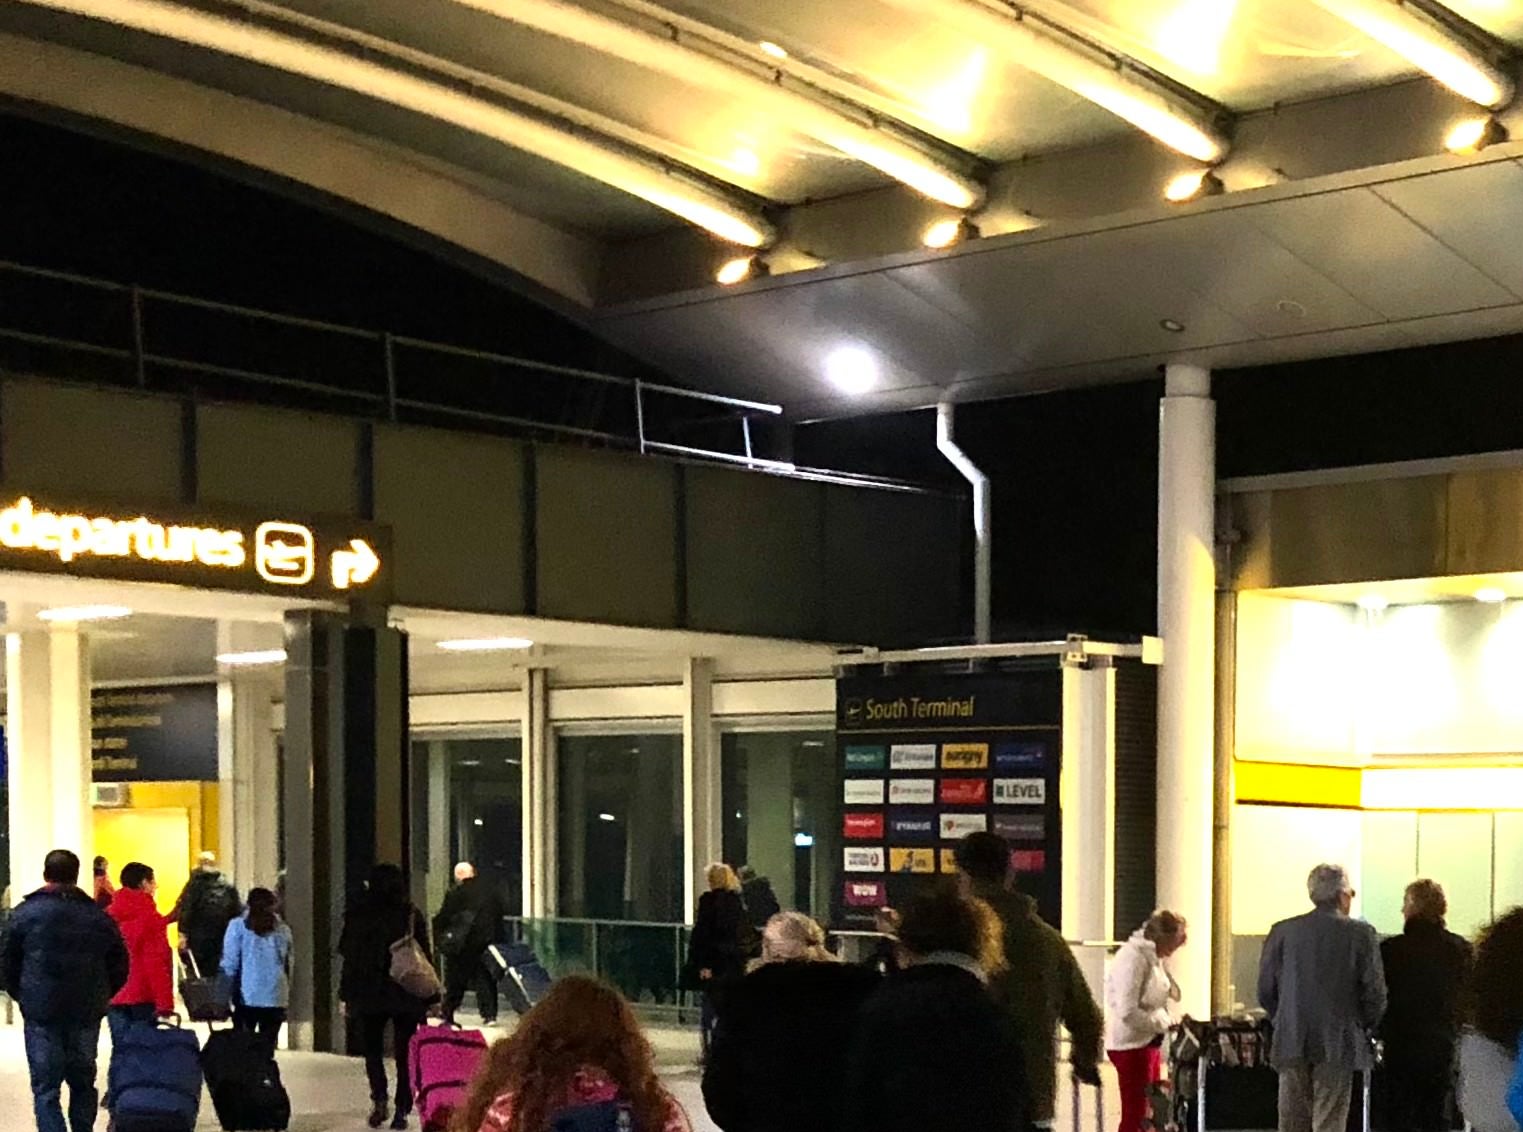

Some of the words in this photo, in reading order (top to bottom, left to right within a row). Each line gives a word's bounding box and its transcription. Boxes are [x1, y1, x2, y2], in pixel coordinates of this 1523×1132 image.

[0, 496, 246, 567] departures
[866, 698, 908, 719] South
[911, 695, 975, 719] Terminal
[1006, 784, 1042, 798] LEVEL
